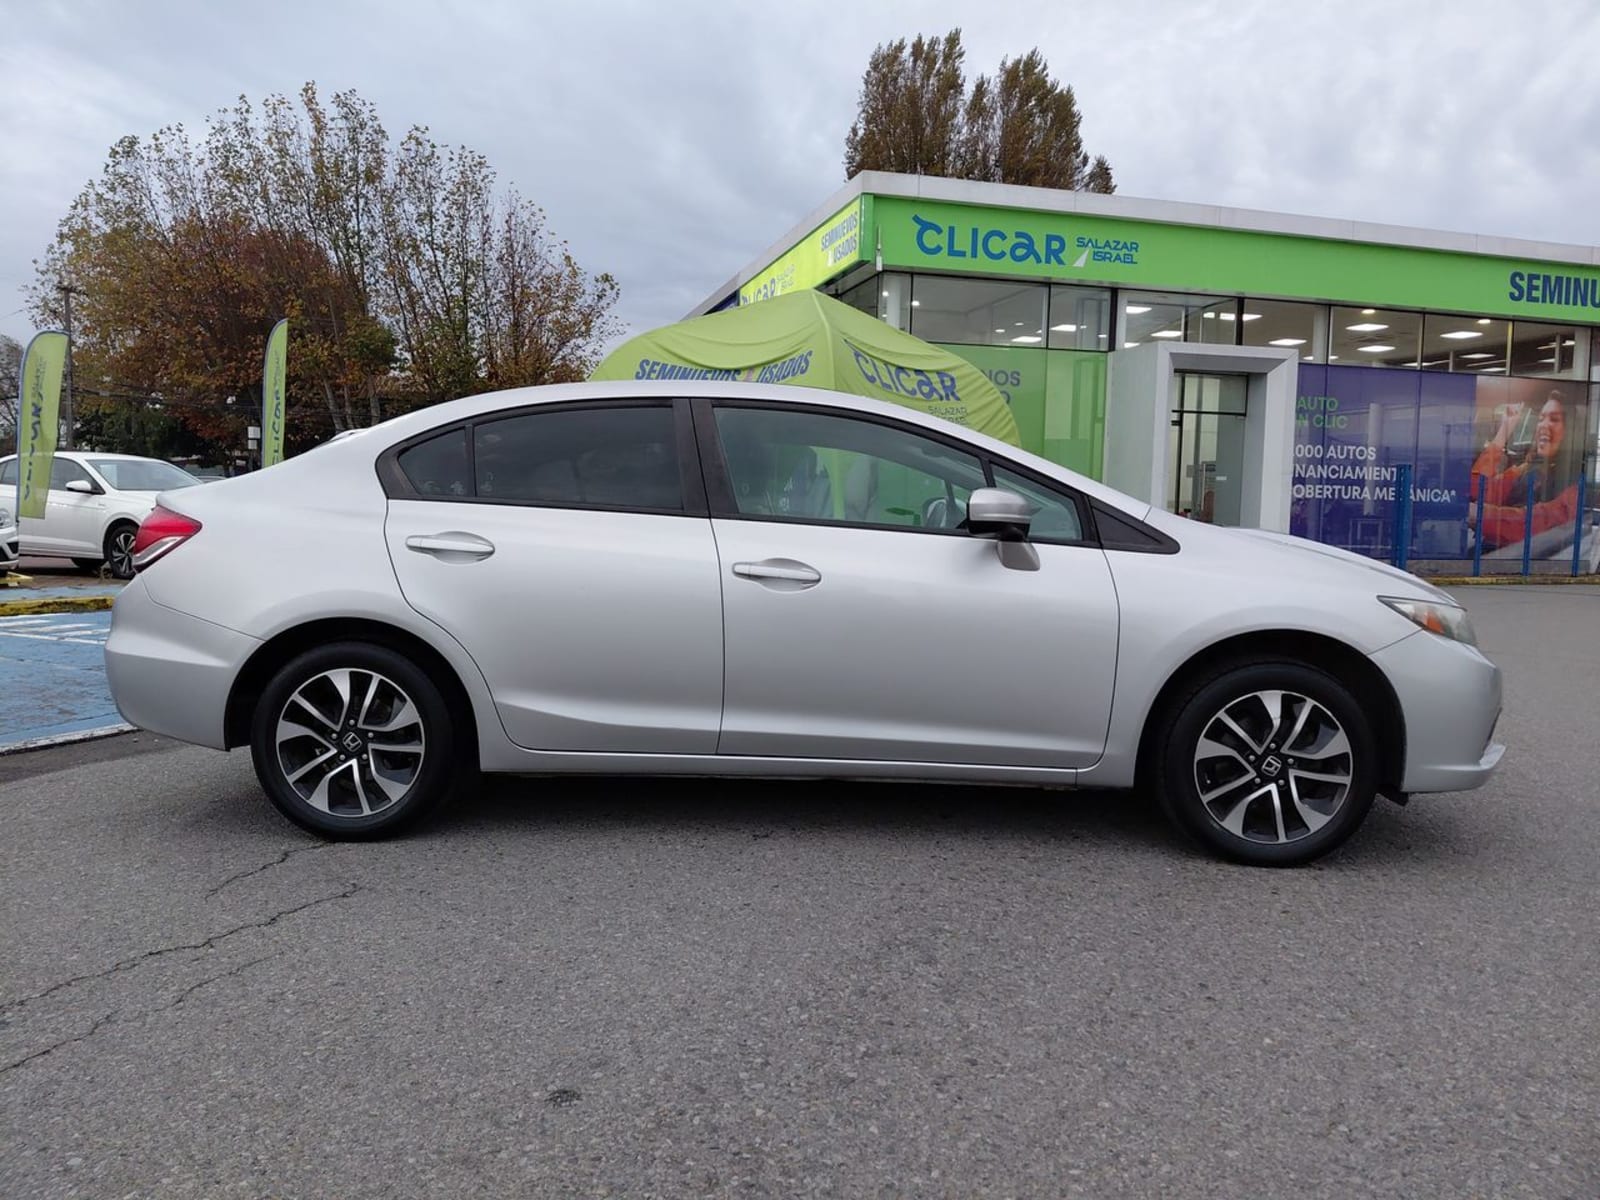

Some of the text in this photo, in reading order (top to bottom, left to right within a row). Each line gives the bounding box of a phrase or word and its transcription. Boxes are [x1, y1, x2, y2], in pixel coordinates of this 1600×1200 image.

[1076, 236, 1140, 253] SALAZAR
[1092, 250, 1138, 265] ISRAEL
[1297, 396, 1338, 411] AUTO
[1312, 414, 1349, 429] CLIC
[1326, 445, 1377, 460] AUTOS
